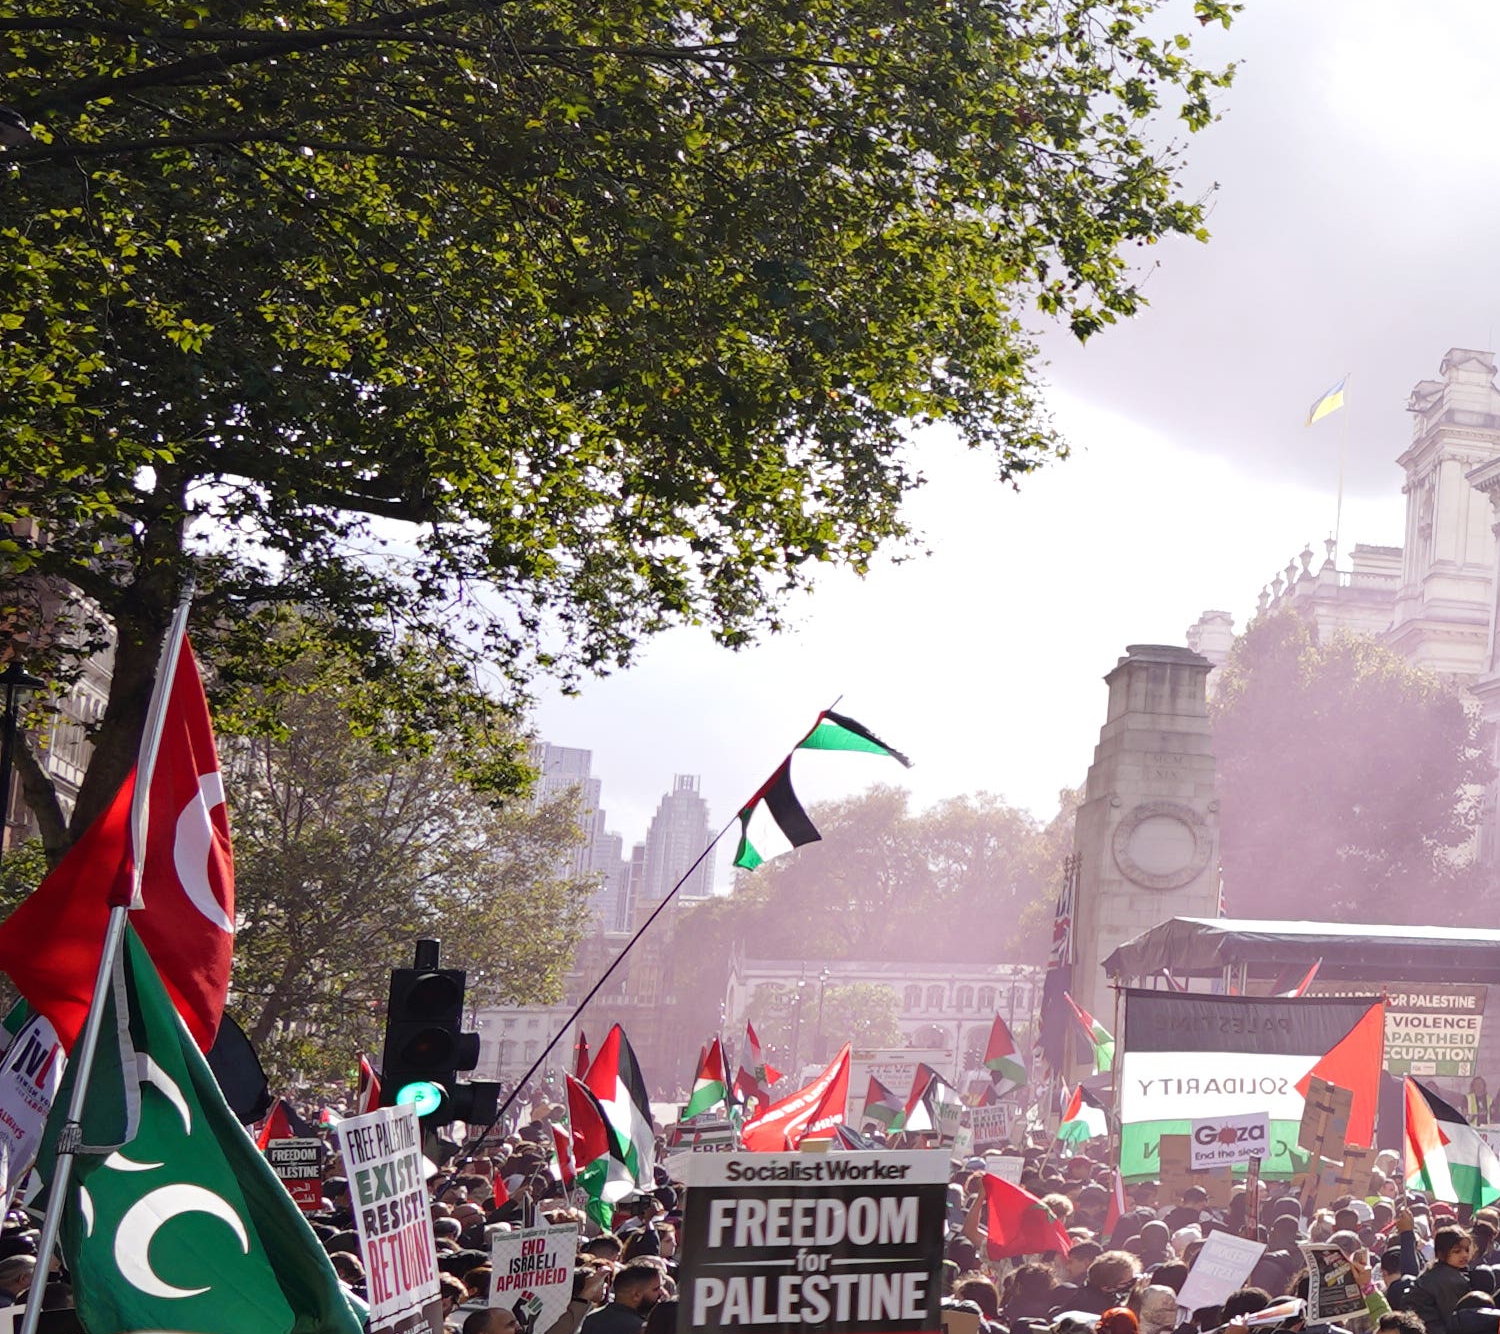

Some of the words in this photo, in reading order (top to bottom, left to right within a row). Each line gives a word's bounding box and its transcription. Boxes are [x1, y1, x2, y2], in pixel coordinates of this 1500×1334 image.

[1409, 994, 1476, 1008] PALESTINE
[1392, 1016, 1477, 1029] VIOLENCE
[1384, 1047, 1474, 1061] CCUPATION
[346, 1125, 377, 1165] FREE
[376, 1113, 417, 1160] PALESTINE
[271, 1147, 317, 1162] FREEDOM
[1195, 1151, 1215, 1161] End
[1218, 1149, 1235, 1159] the
[354, 1151, 421, 1205] EXIST!
[726, 1160, 824, 1182] Socialist
[825, 1159, 913, 1181] Worker
[361, 1191, 425, 1239] RESIST!
[707, 1196, 920, 1248] FREEDOM
[521, 1238, 546, 1256] END
[367, 1220, 434, 1307] RETURN!
[509, 1252, 557, 1272] ISRAELI
[796, 1247, 832, 1272] for
[496, 1267, 568, 1293] APARTHEID
[692, 1271, 929, 1327] PALESTINE
